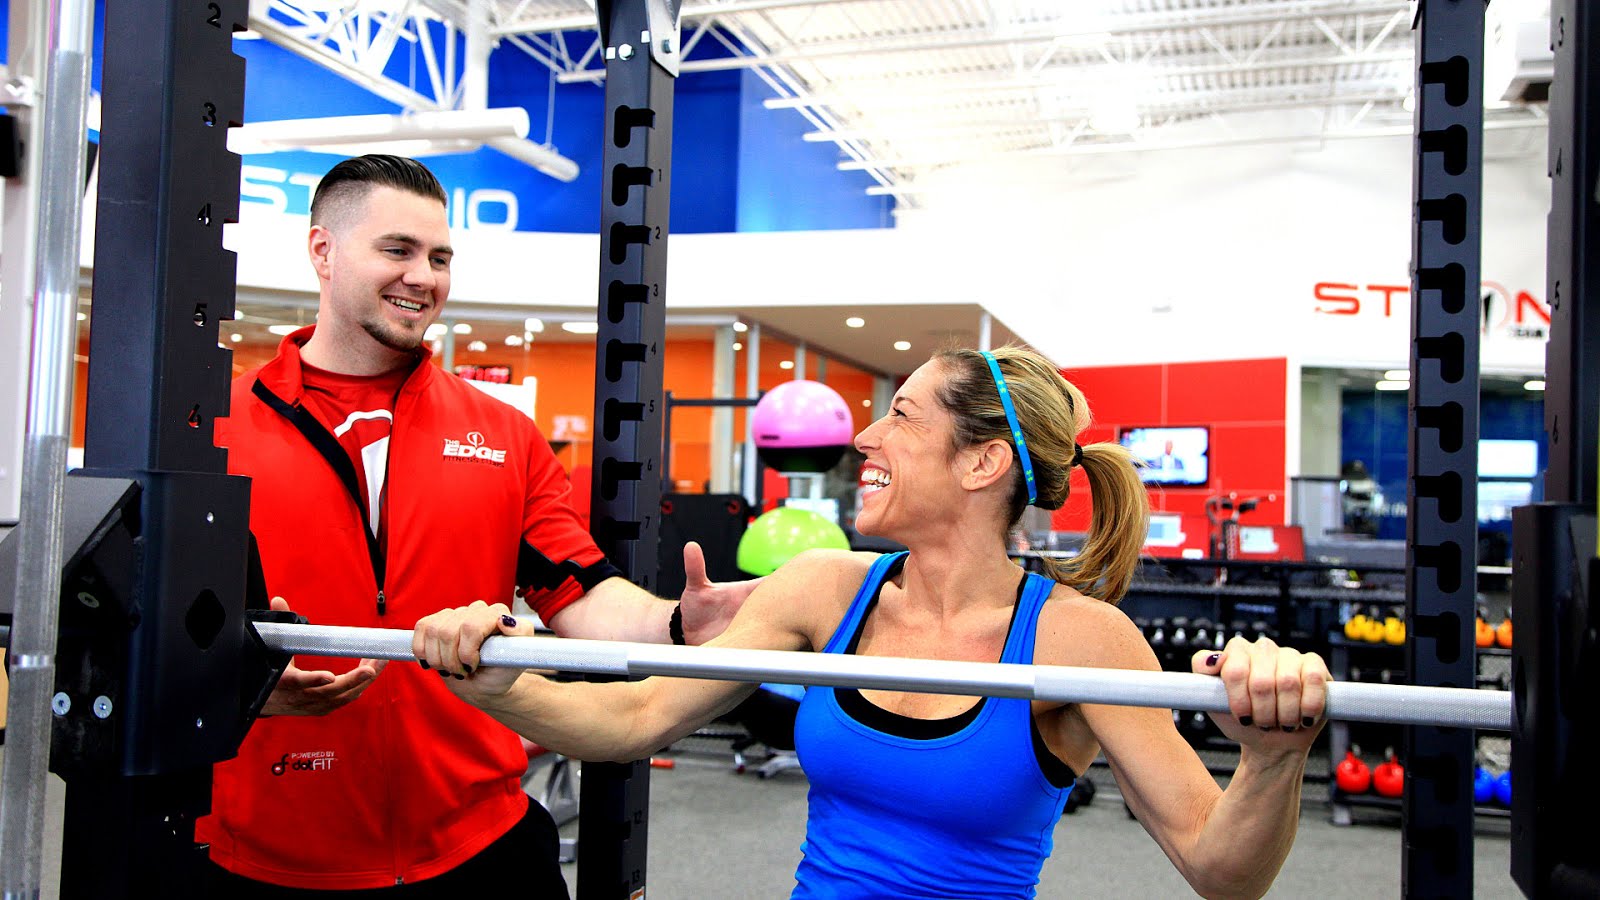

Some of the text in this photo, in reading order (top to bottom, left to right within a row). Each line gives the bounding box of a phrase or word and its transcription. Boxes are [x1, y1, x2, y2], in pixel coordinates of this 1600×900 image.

[206, 2, 222, 29] 2
[1558, 16, 1565, 48] 3
[202, 102, 217, 127] 3
[1555, 147, 1562, 177] 4
[657, 168, 663, 183] 1
[196, 202, 213, 228] 4
[654, 226, 662, 240] 2
[652, 283, 659, 297] 3
[1554, 280, 1561, 311] 5
[192, 302, 208, 327] 5
[650, 341, 657, 356] 4
[648, 399, 655, 413] 5
[187, 403, 202, 429] 6
[1552, 414, 1559, 445] 6
[443, 438, 460, 446] THE
[442, 443, 507, 463] EDGE
[443, 455, 480, 464] FITNESS
[646, 457, 653, 472] 6
[644, 516, 651, 529] 7
[642, 574, 649, 588] 8
[291, 751, 326, 759] POWERED
[292, 757, 336, 771] dotFIT
